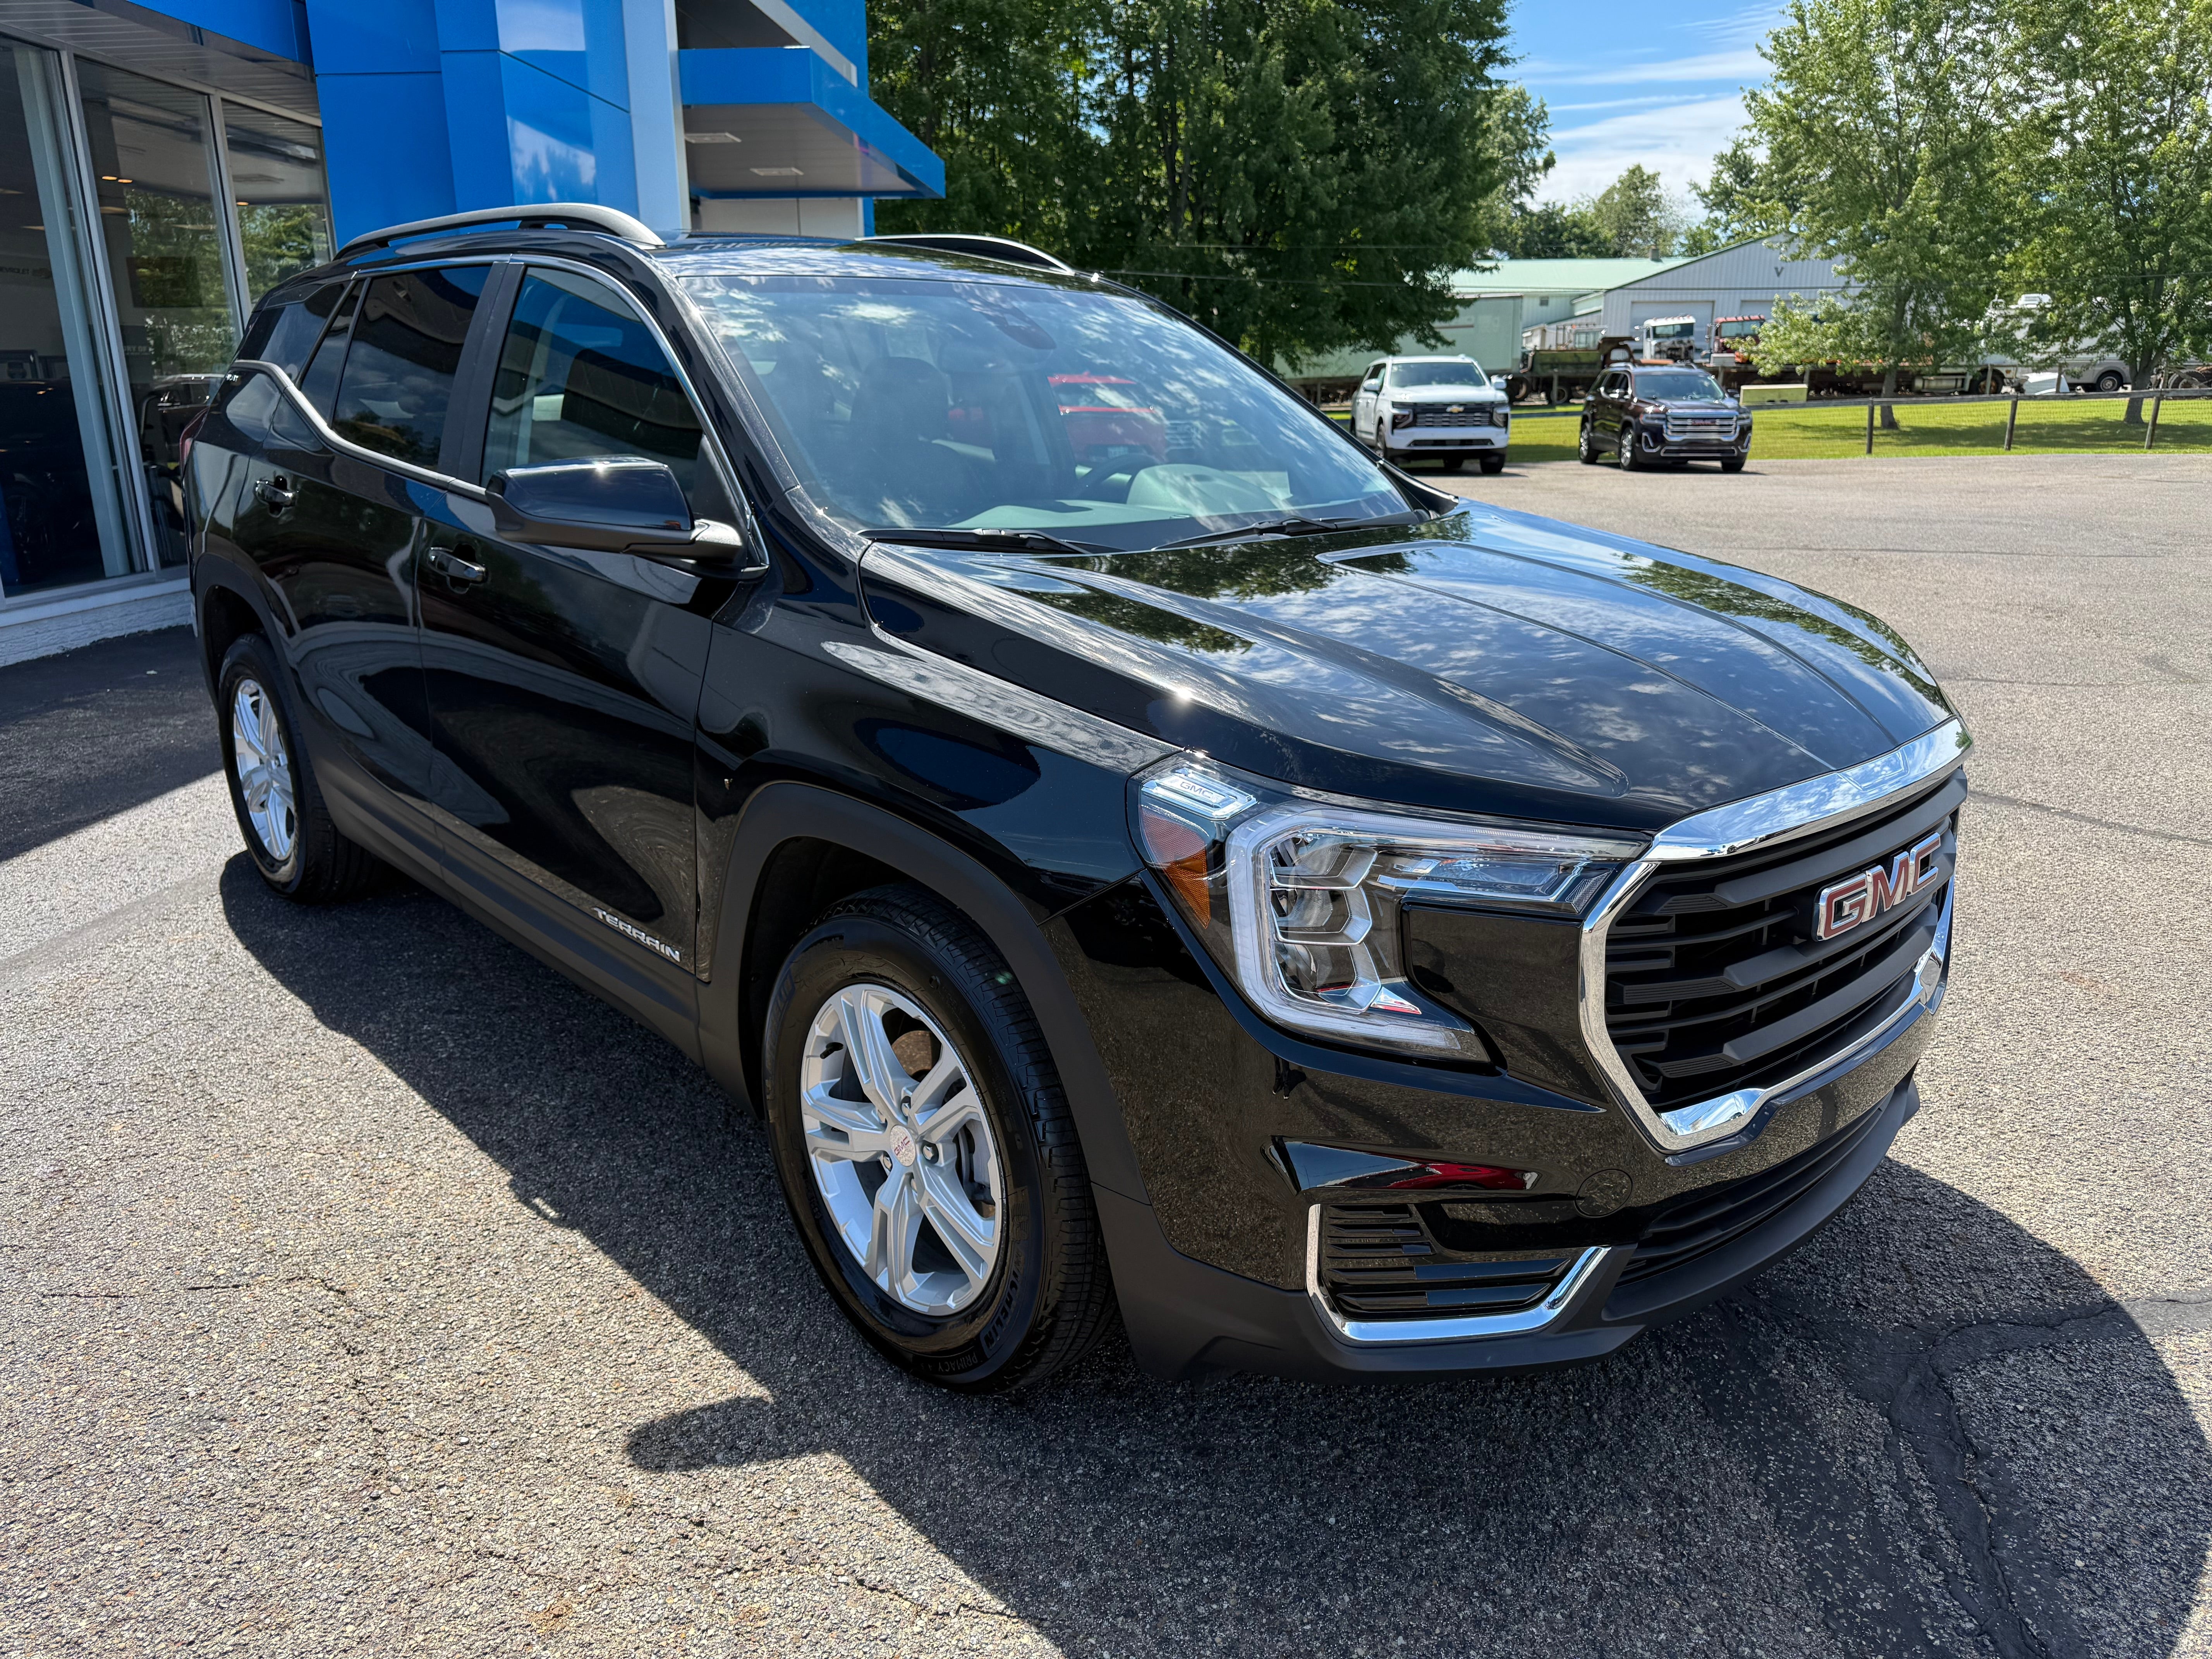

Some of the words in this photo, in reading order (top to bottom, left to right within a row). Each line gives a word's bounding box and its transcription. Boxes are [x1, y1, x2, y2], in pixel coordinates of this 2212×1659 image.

[1180, 781, 1213, 798] GMC
[1817, 832, 1941, 941] GMC
[591, 907, 681, 962] TERRAIN
[894, 1136, 910, 1156] GMC
[938, 1351, 978, 1372] PRIMACY
